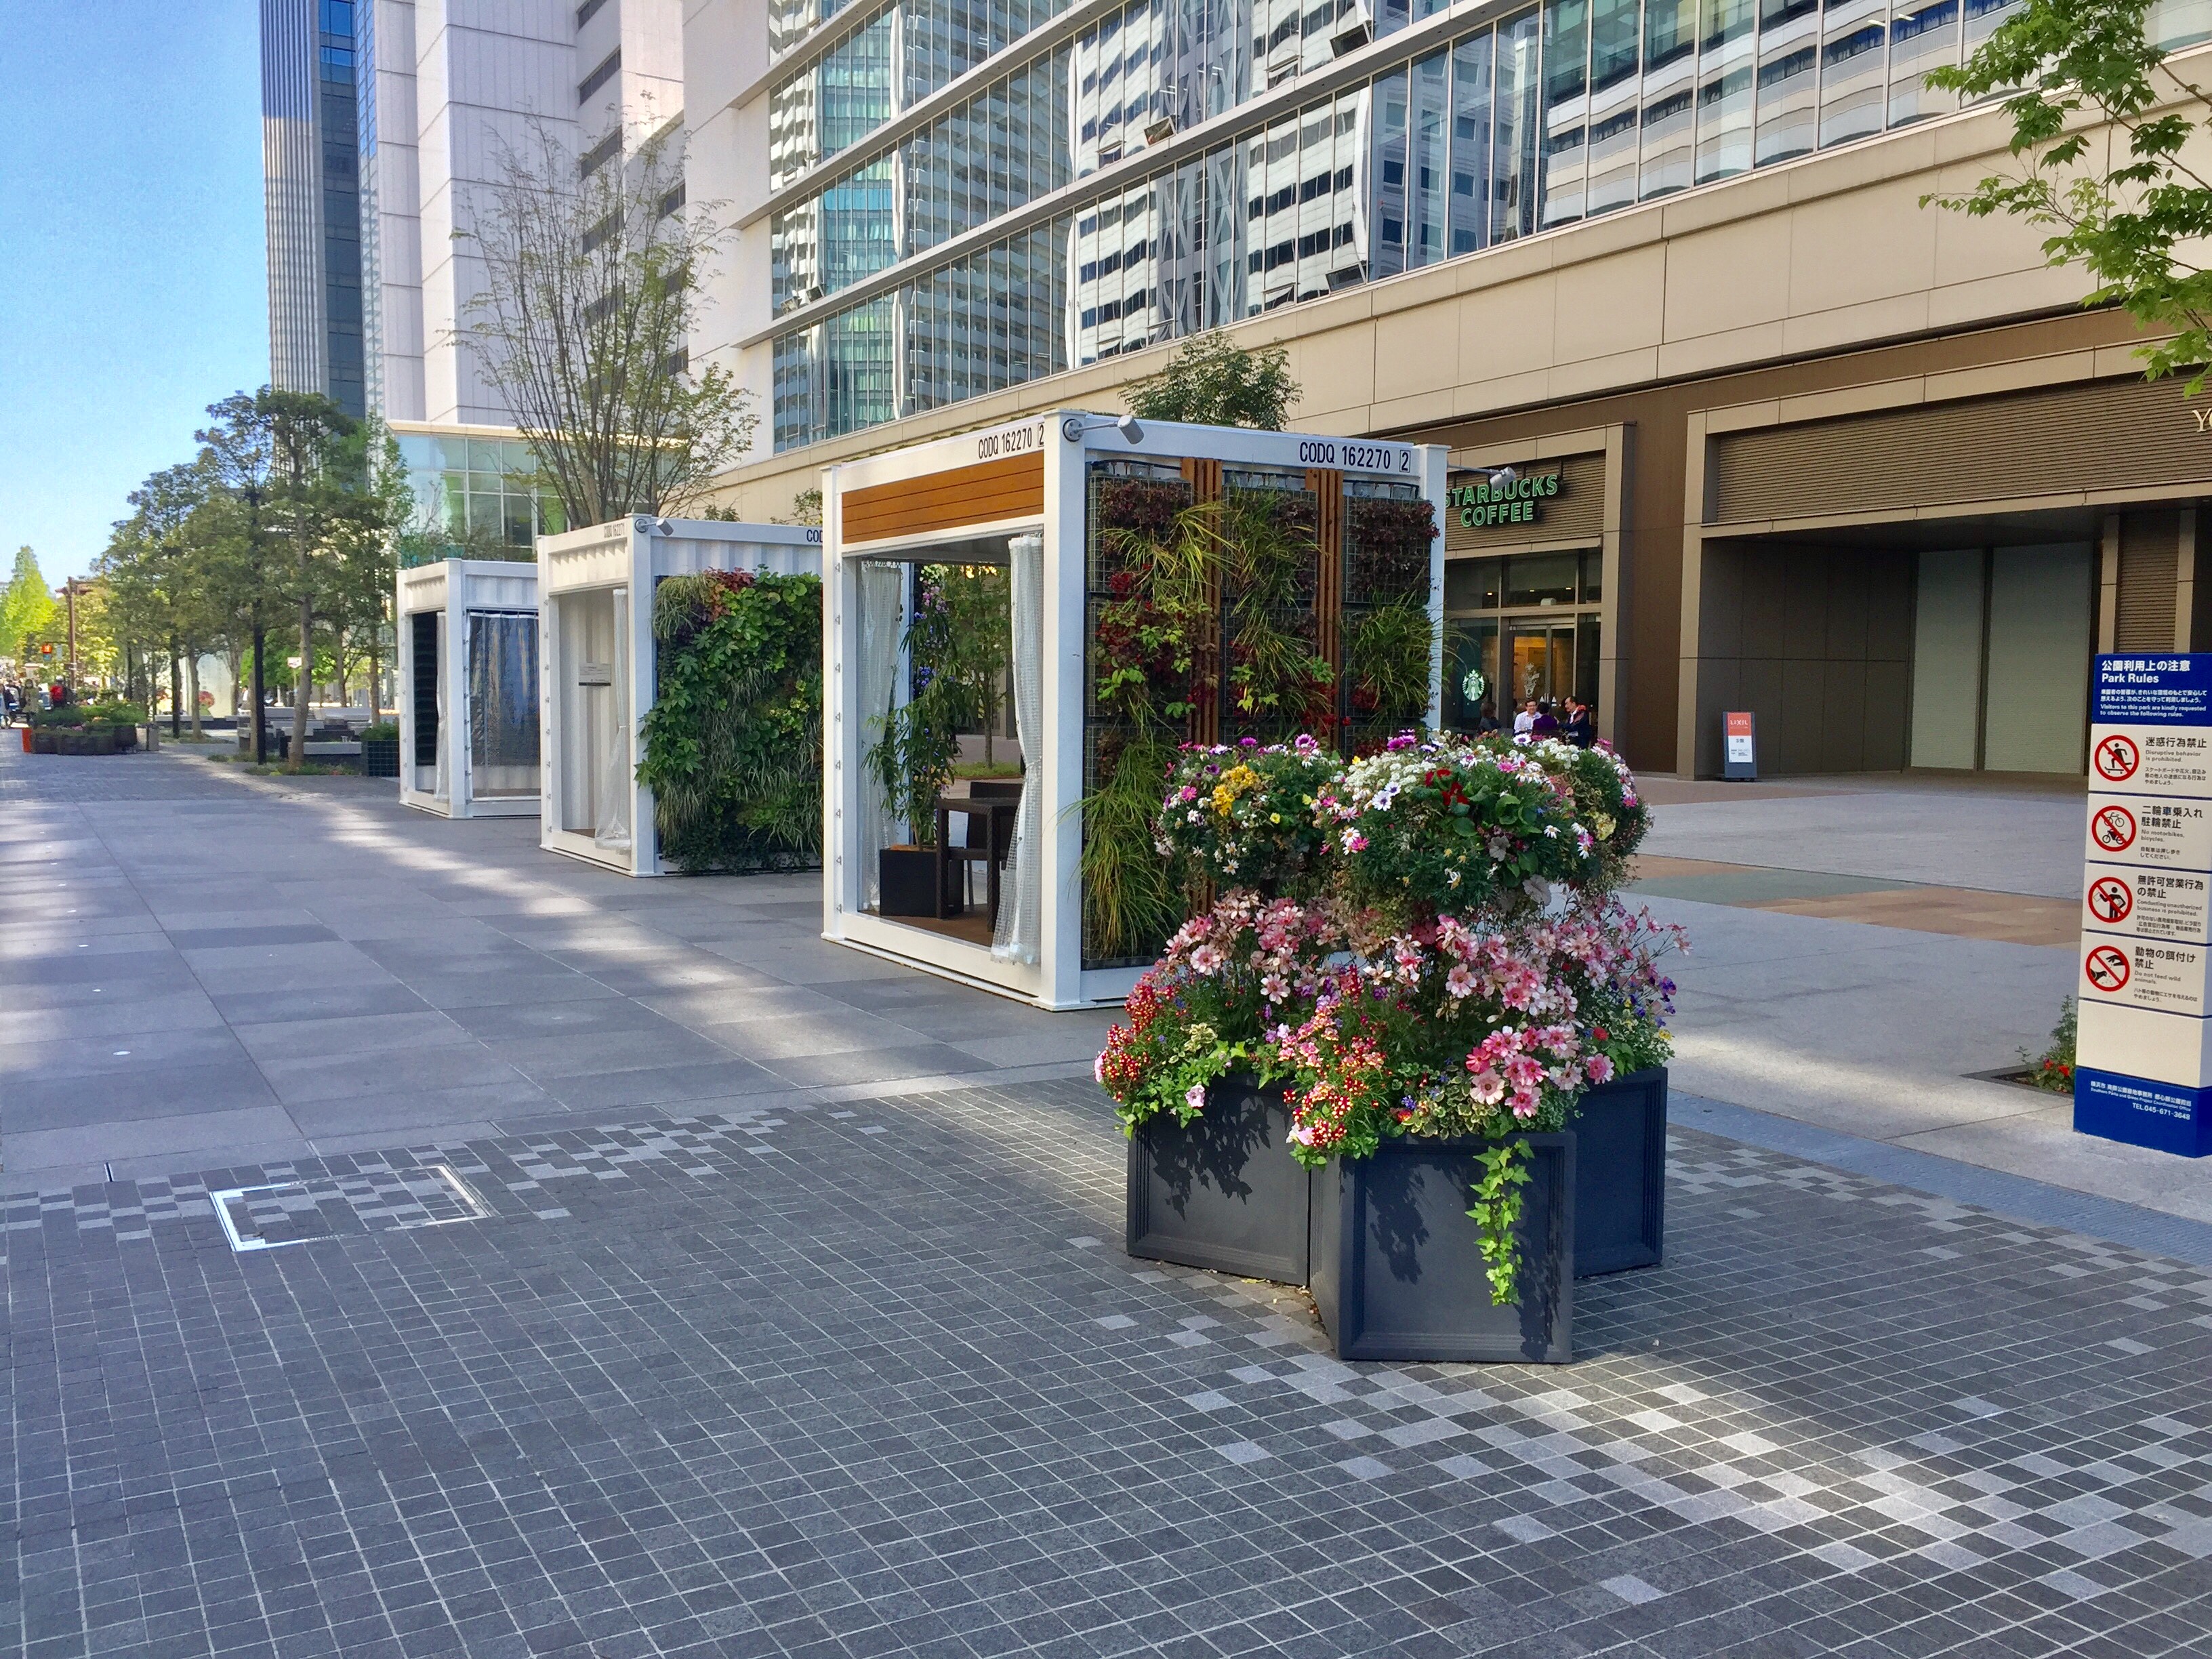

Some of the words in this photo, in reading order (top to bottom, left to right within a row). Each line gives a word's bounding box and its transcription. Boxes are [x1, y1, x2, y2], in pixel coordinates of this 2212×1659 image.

[2192, 408, 2212, 432] Y
[978, 434, 998, 459] CODQ
[1002, 427, 1032, 453] 162270
[1040, 424, 1044, 445] 2
[1300, 442, 1334, 464] CODQ
[1342, 445, 1391, 470] 162270
[1401, 452, 1409, 471] 2
[1460, 501, 1534, 527] COFFEE
[2102, 660, 2191, 672] 公園利用上の注意
[2102, 673, 2125, 683] Park
[2128, 674, 2159, 683] Rules
[2145, 737, 2207, 748] 迷惑行為禁止
[2142, 805, 2203, 818] 二輪車乗入れ
[2142, 817, 2182, 829] 駐輪禁止
[2137, 875, 2204, 890] 無許可営業行為
[2137, 887, 2167, 899] の禁止
[2137, 899, 2167, 907] Conducting
[2135, 946, 2196, 962] 動物の餌付け
[2135, 958, 2154, 969] 禁止
[2132, 1103, 2190, 1120] TEL.045-671-3648
